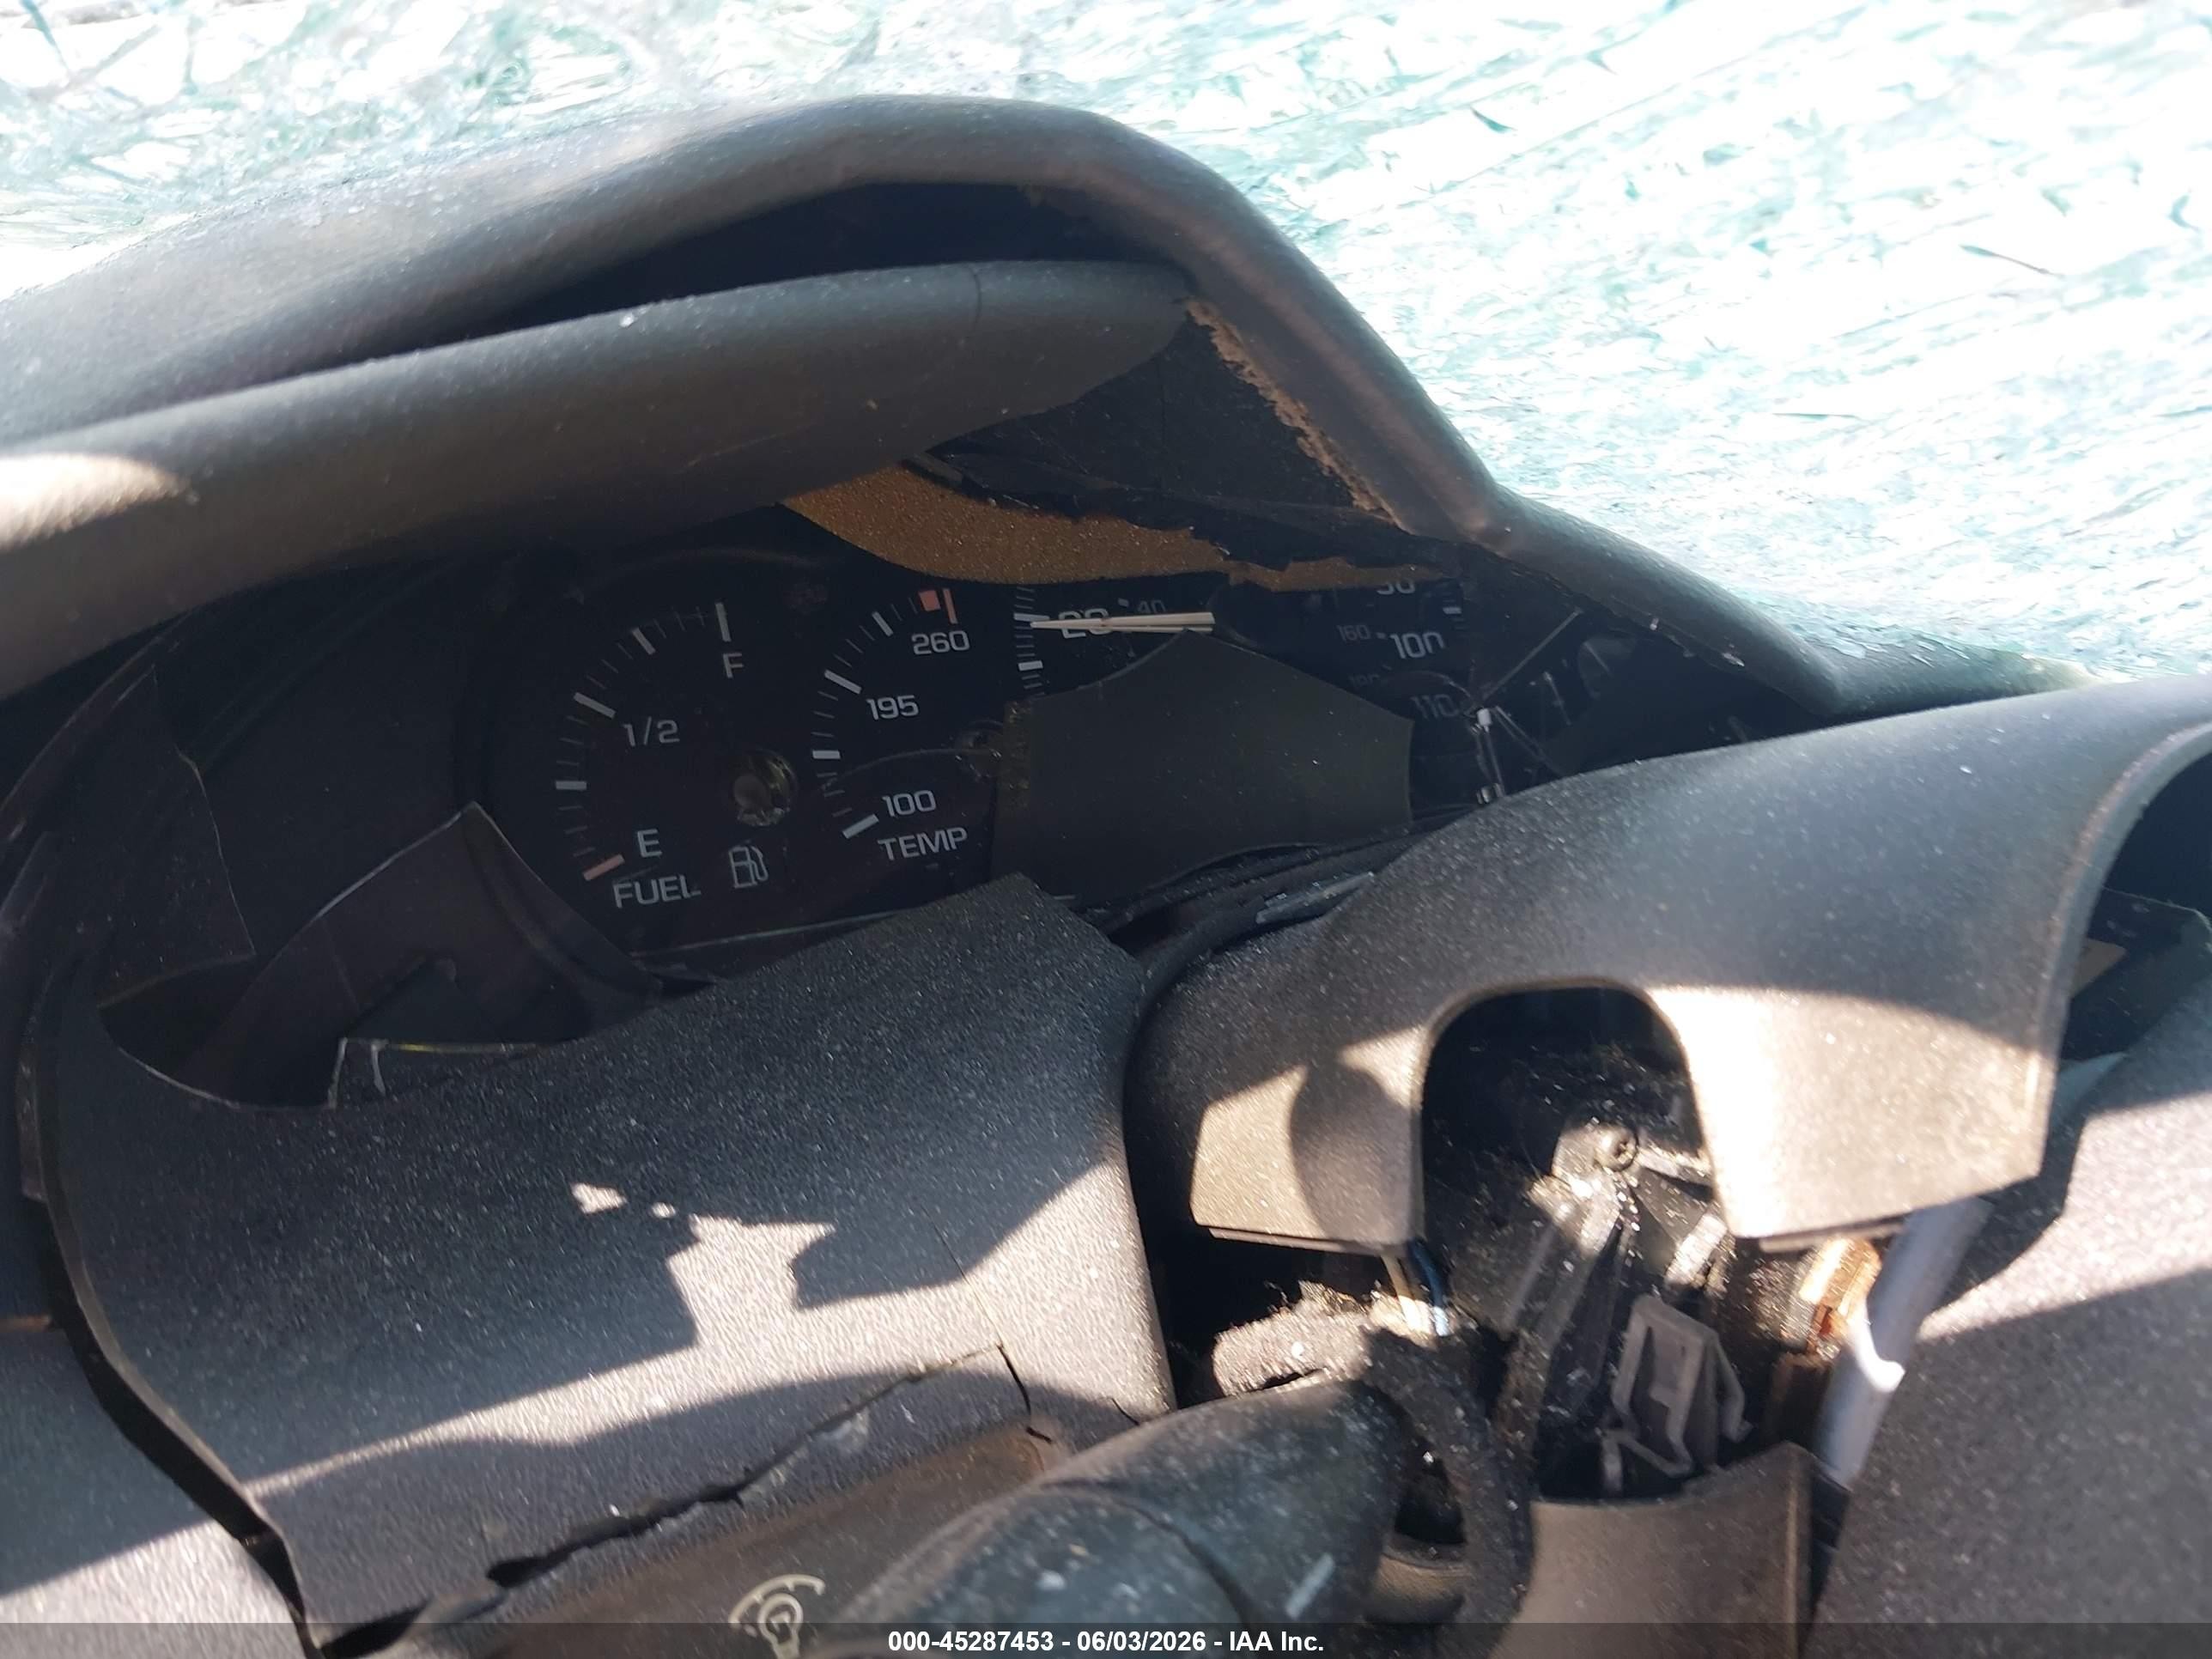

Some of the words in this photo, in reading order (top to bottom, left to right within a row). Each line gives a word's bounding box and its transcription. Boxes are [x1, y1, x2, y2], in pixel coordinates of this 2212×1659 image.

[1058, 607, 1113, 639] 20
[912, 630, 970, 656] 260
[722, 652, 745, 678] F
[866, 694, 920, 721] 195
[623, 716, 681, 747] 1/2
[883, 789, 938, 817] 100
[636, 829, 662, 860] E
[878, 826, 969, 861] TEMP
[612, 874, 702, 909] FUEL
